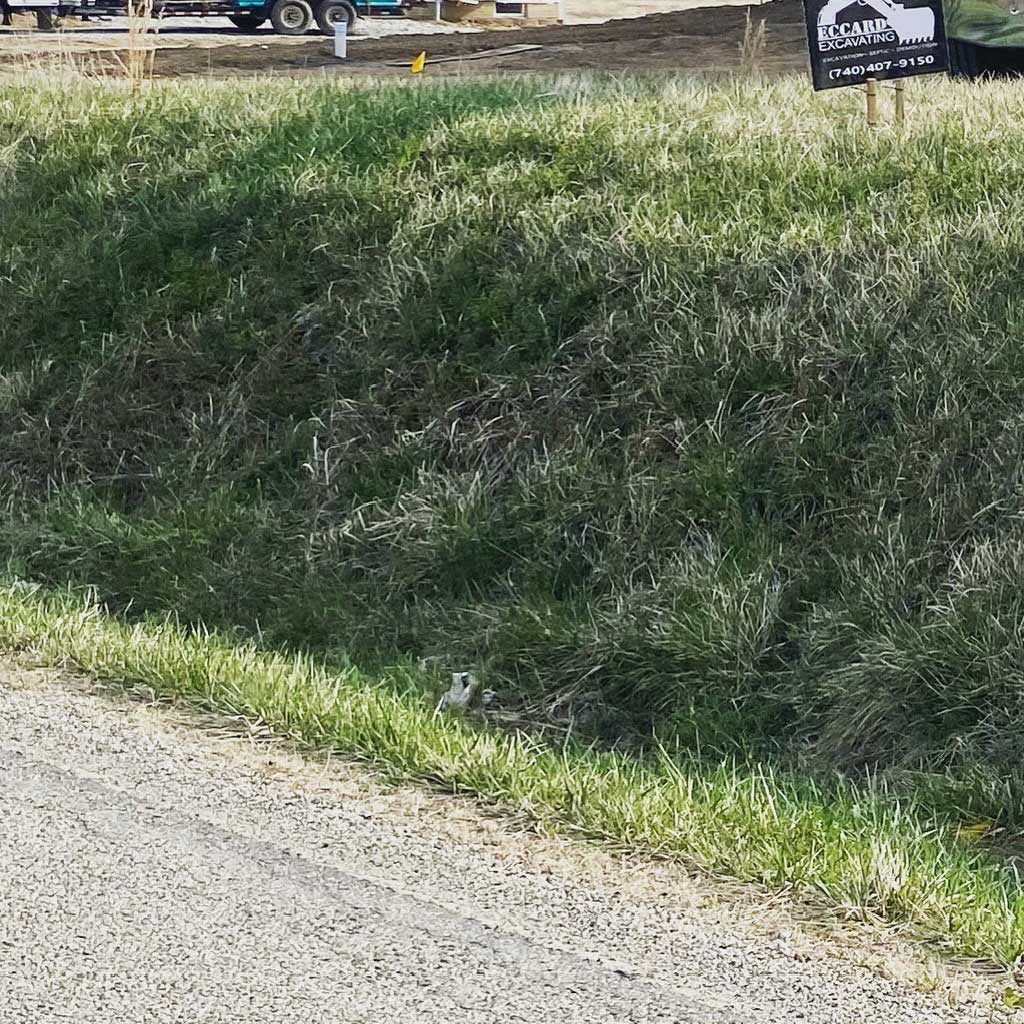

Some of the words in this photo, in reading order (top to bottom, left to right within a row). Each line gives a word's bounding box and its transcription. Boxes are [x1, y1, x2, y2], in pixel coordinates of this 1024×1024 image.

[817, 18, 887, 40] ECCARD
[818, 32, 895, 52] EXCAVATING
[828, 55, 935, 80] (740)407-9150
